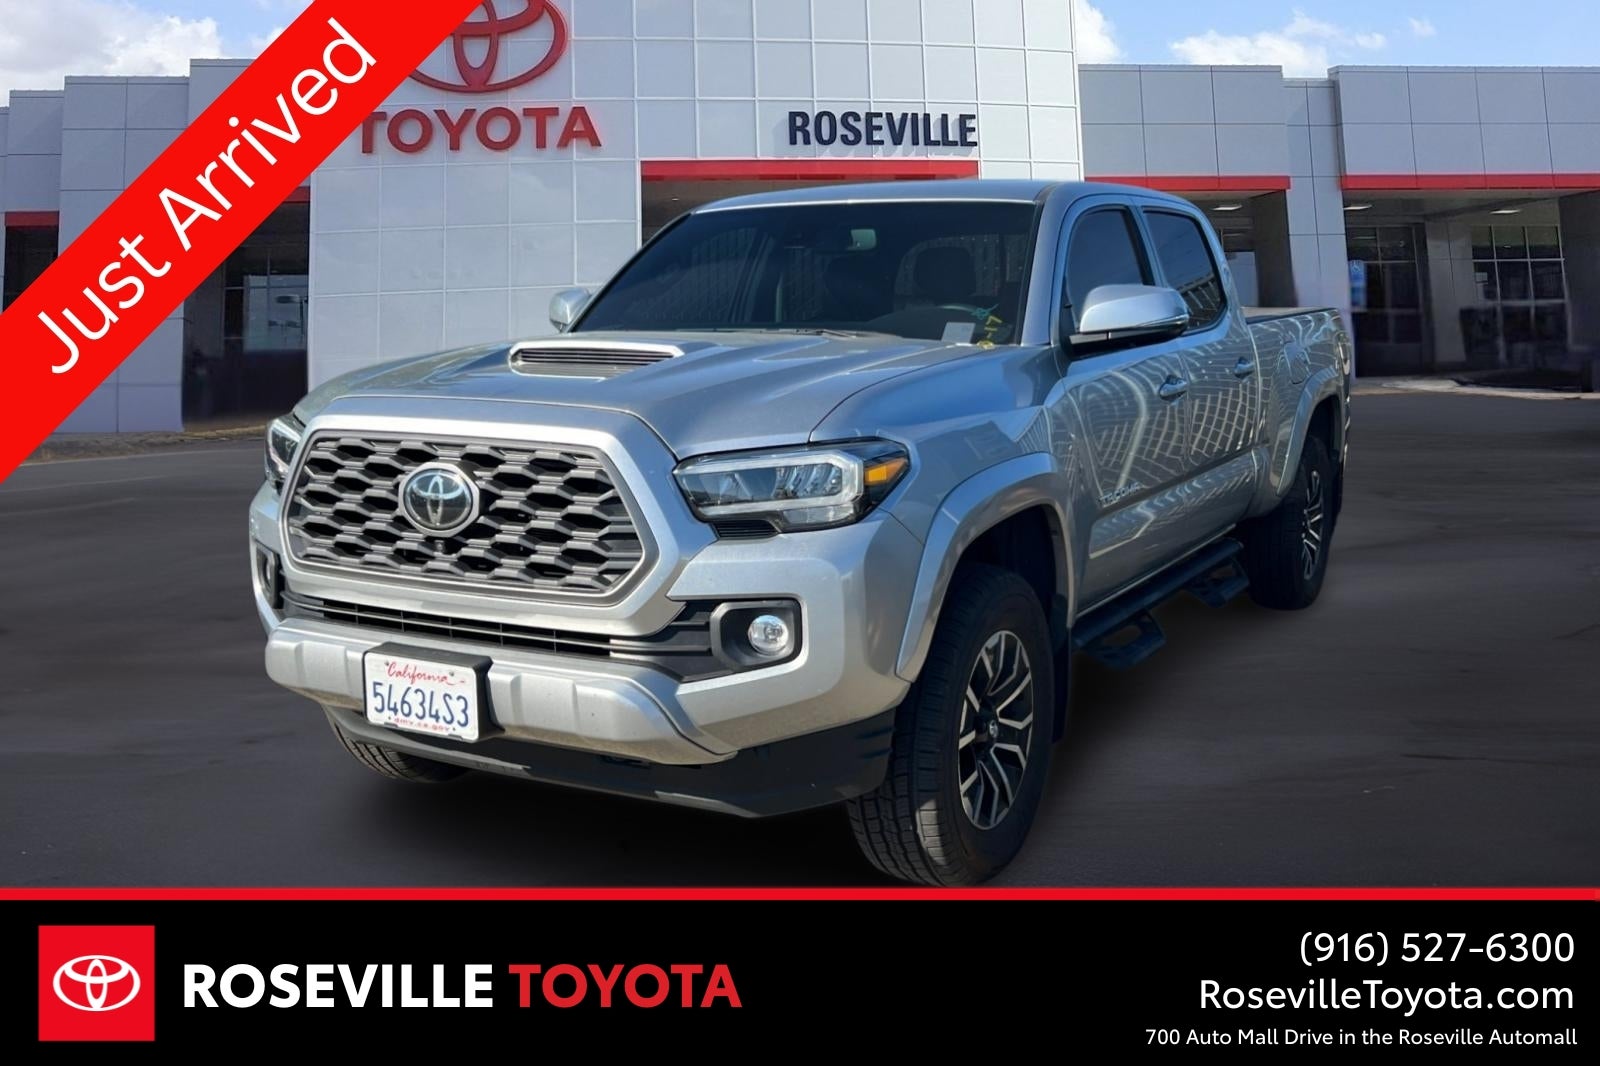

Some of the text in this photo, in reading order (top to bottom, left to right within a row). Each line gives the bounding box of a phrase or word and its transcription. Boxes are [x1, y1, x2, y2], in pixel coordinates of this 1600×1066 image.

[362, 106, 602, 153] TOYOTA
[788, 110, 978, 147] ROSEVILLE
[387, 661, 459, 685] California
[372, 681, 469, 727] 54634S3
